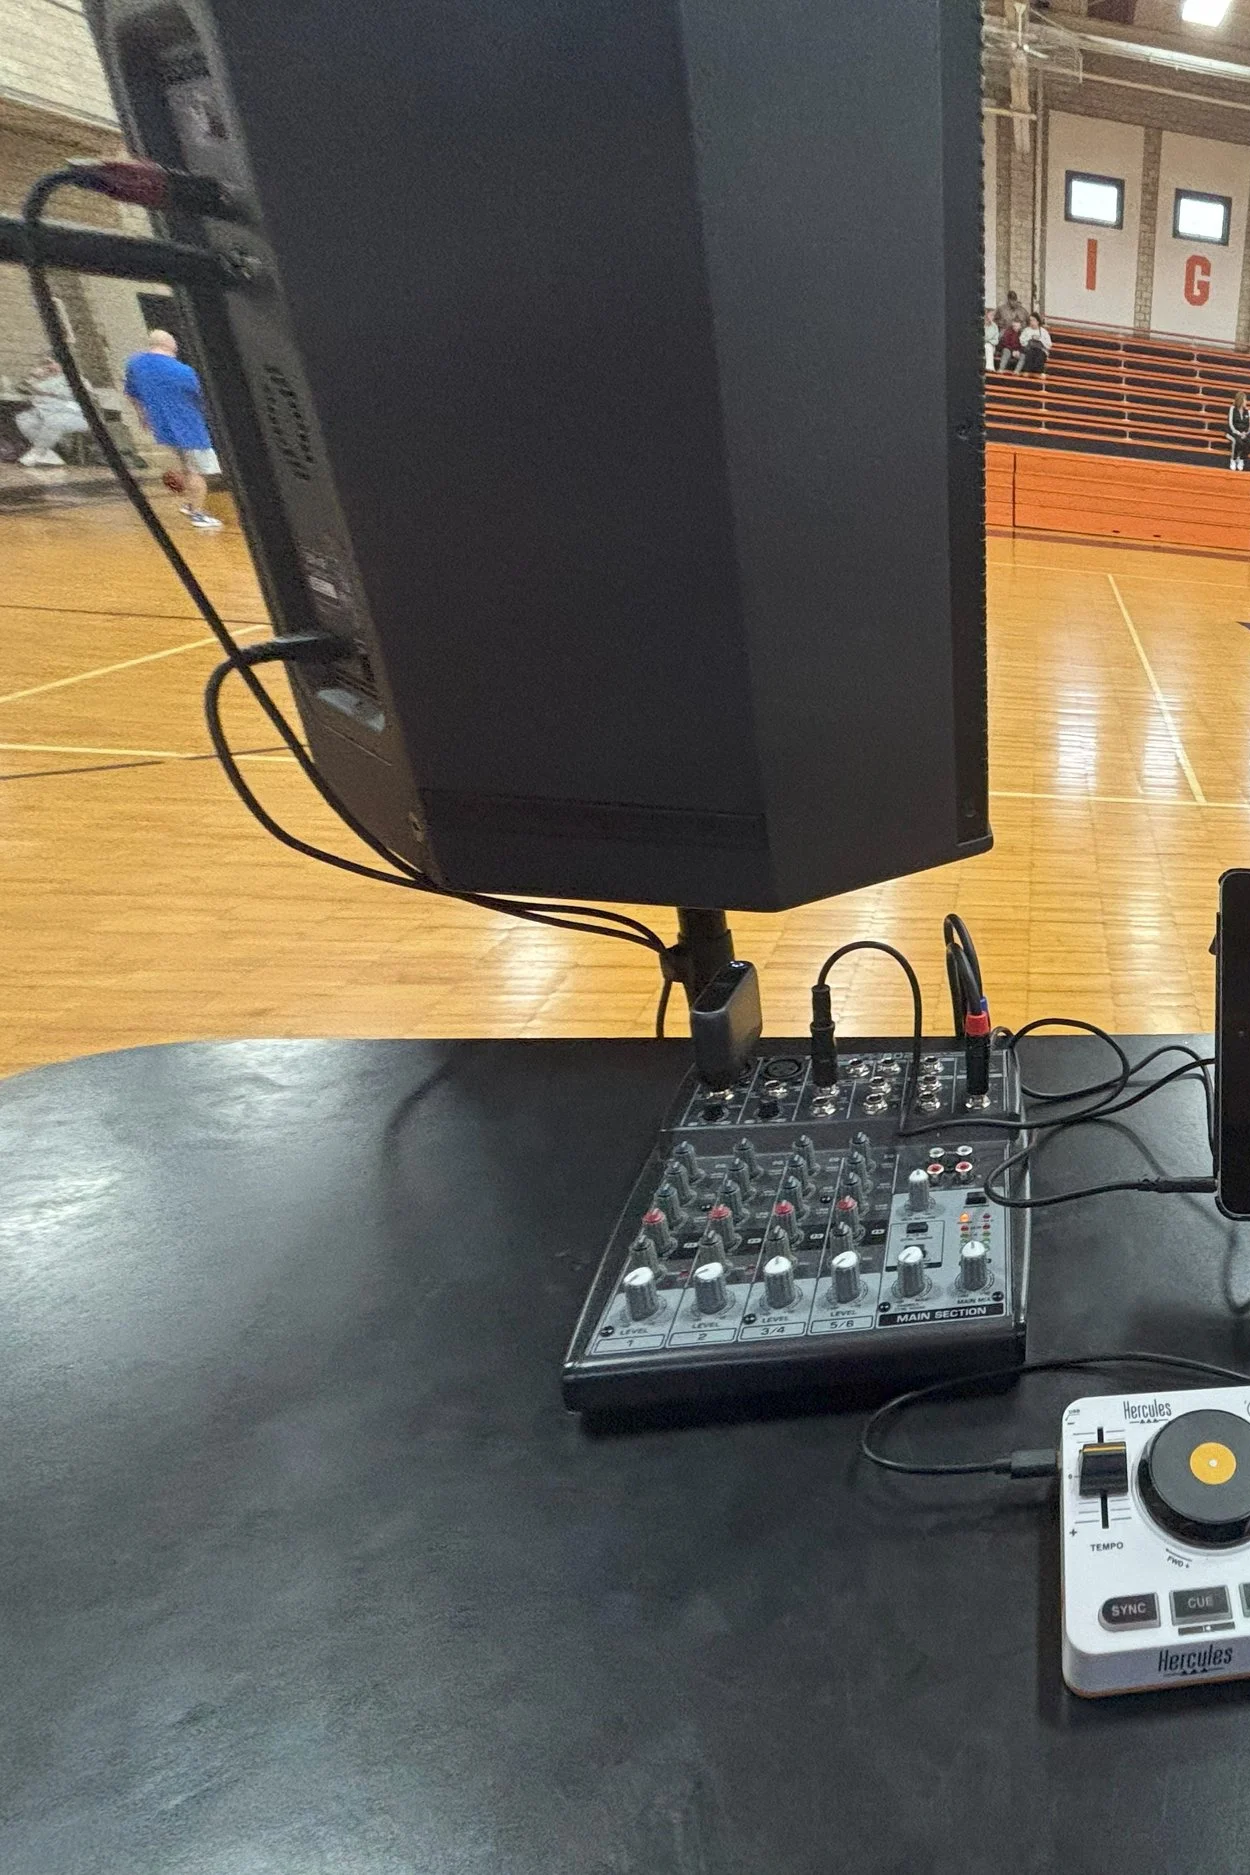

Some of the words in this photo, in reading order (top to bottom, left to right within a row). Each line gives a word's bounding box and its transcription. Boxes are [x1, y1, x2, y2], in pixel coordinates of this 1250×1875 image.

[896, 1311, 931, 1323] MAIN
[934, 1306, 987, 1319] SECTION
[692, 1321, 720, 1329] LEVEL
[830, 1319, 854, 1329] 5/6
[620, 1327, 648, 1336] LEVEL
[697, 1333, 707, 1341] 2
[760, 1326, 785, 1336] 3/4
[1123, 1398, 1172, 1420] Hercules
[1090, 1541, 1124, 1552] TEMPO
[1166, 1555, 1184, 1568] FWD
[1187, 1596, 1214, 1609] CUE
[1111, 1602, 1147, 1617] SYNC
[1158, 1644, 1234, 1673] Hercules
